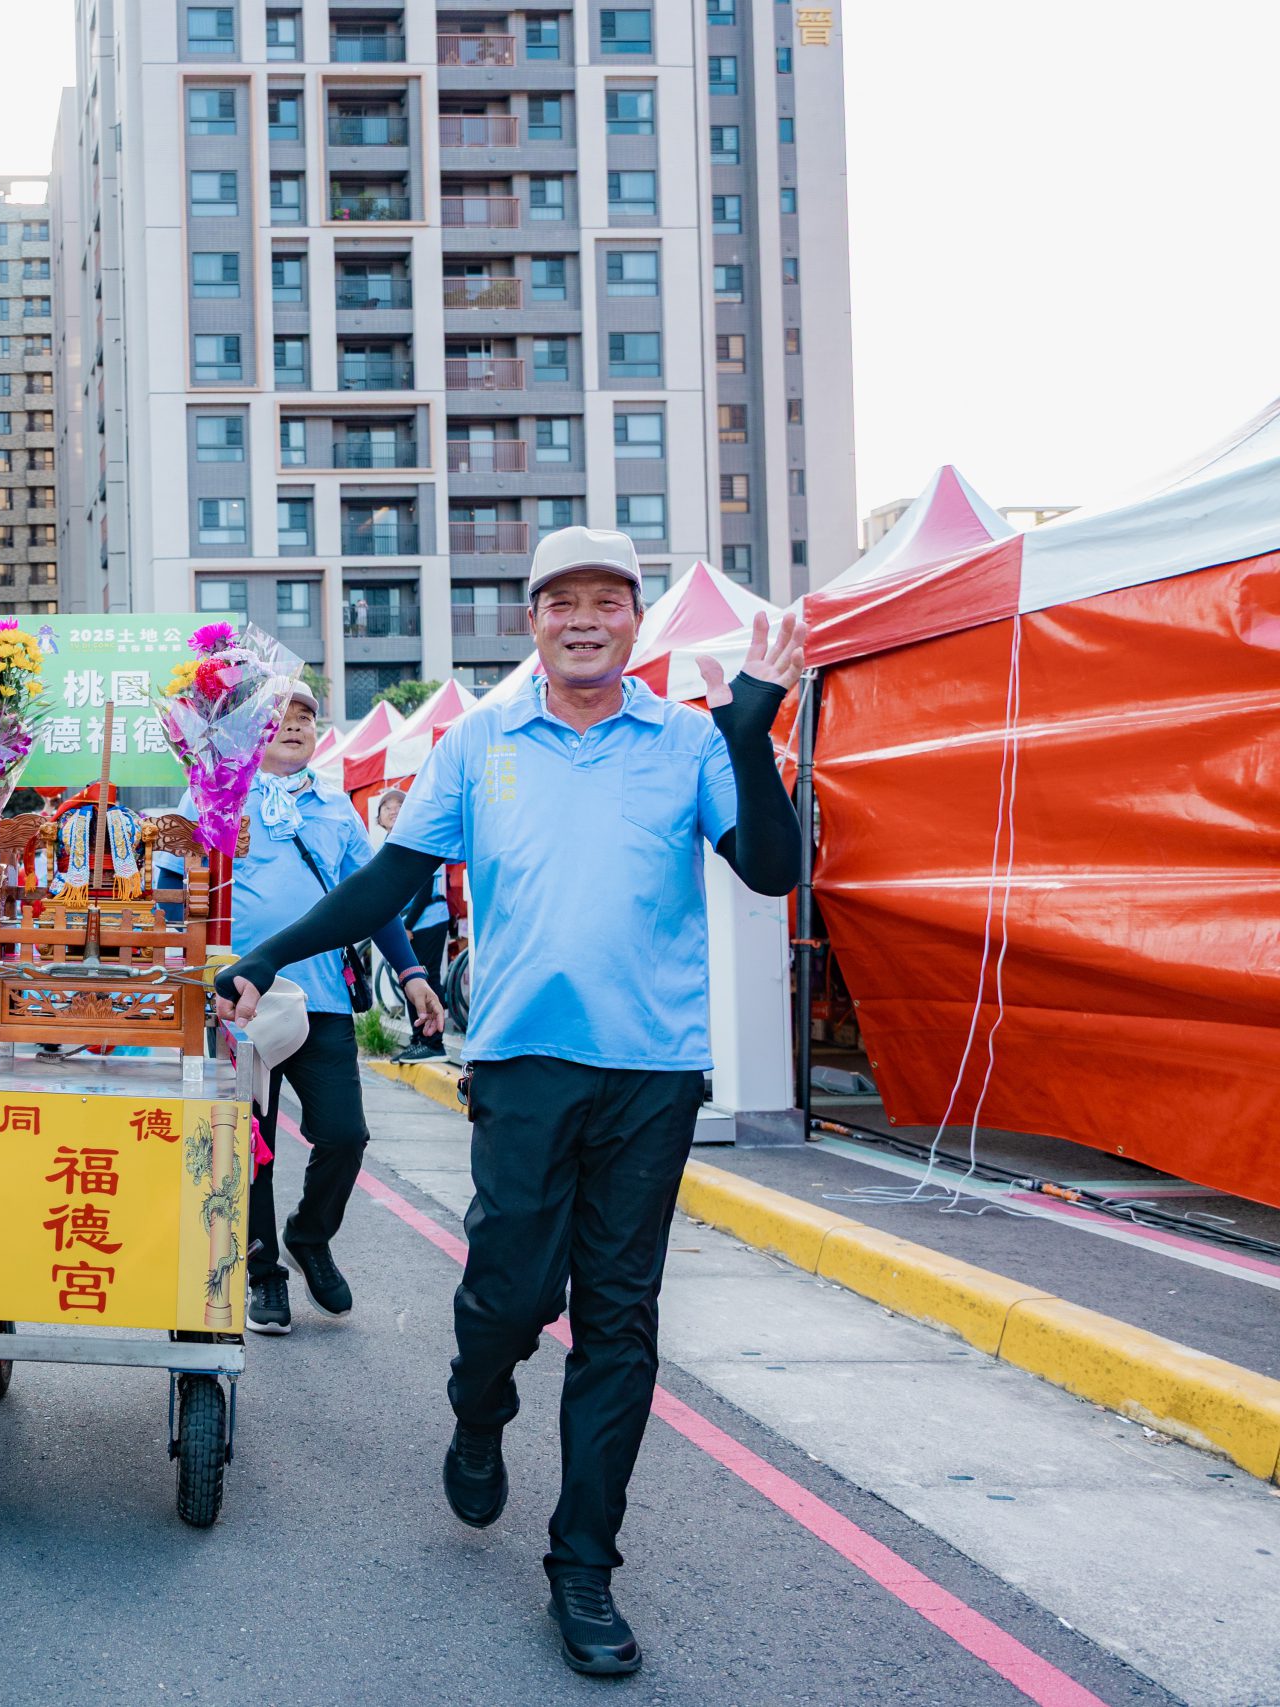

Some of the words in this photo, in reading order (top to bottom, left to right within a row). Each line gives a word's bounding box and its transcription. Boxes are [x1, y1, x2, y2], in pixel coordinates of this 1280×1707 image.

[63, 670, 151, 708] 桃園
[43, 1146, 123, 1314] 福德宮
